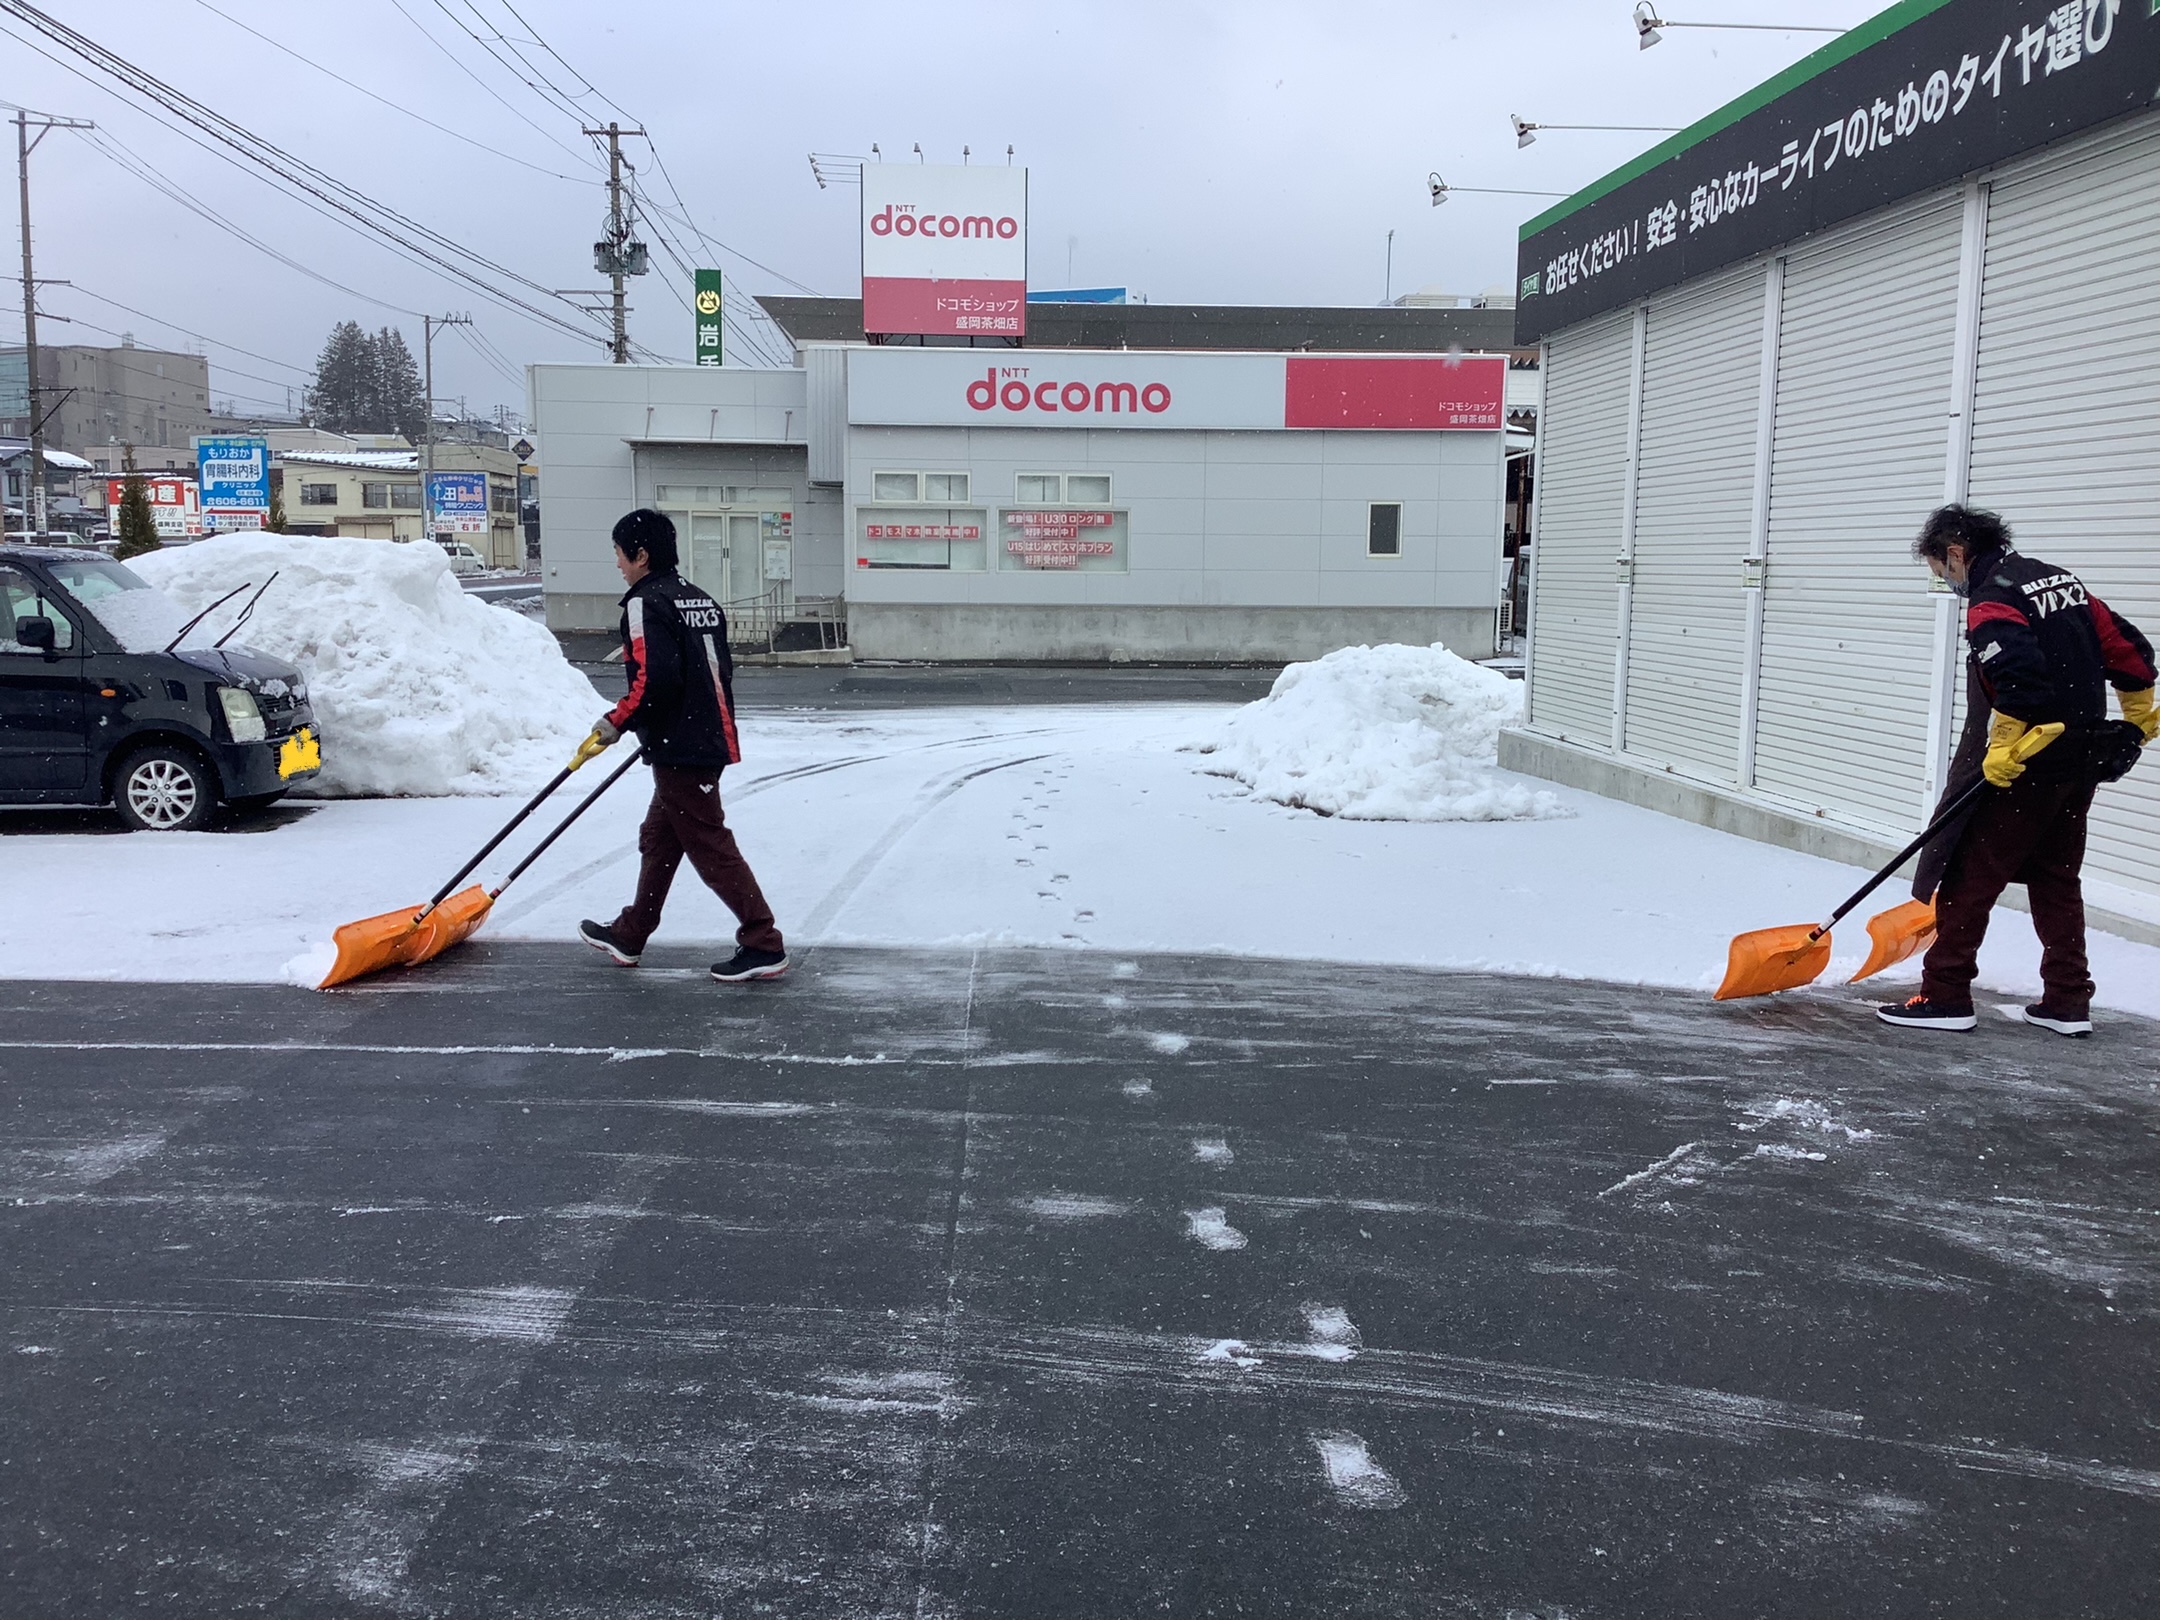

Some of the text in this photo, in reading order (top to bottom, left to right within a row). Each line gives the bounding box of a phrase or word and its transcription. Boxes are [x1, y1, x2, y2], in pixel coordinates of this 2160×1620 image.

[895, 204, 917, 213] NTT
[870, 204, 1018, 239] docomo
[1545, 219, 1639, 295] お任せください!
[936, 297, 1020, 313] ドコモショップ
[955, 316, 1018, 330] 盛岡茶畑店
[1001, 367, 1030, 378] NTT
[966, 367, 1171, 413] docomo
[1438, 401, 1497, 412] ドコモショップ
[208, 448, 250, 459] もりおか
[205, 463, 260, 478] 胃腸科内科
[215, 497, 265, 506] 606-6611
